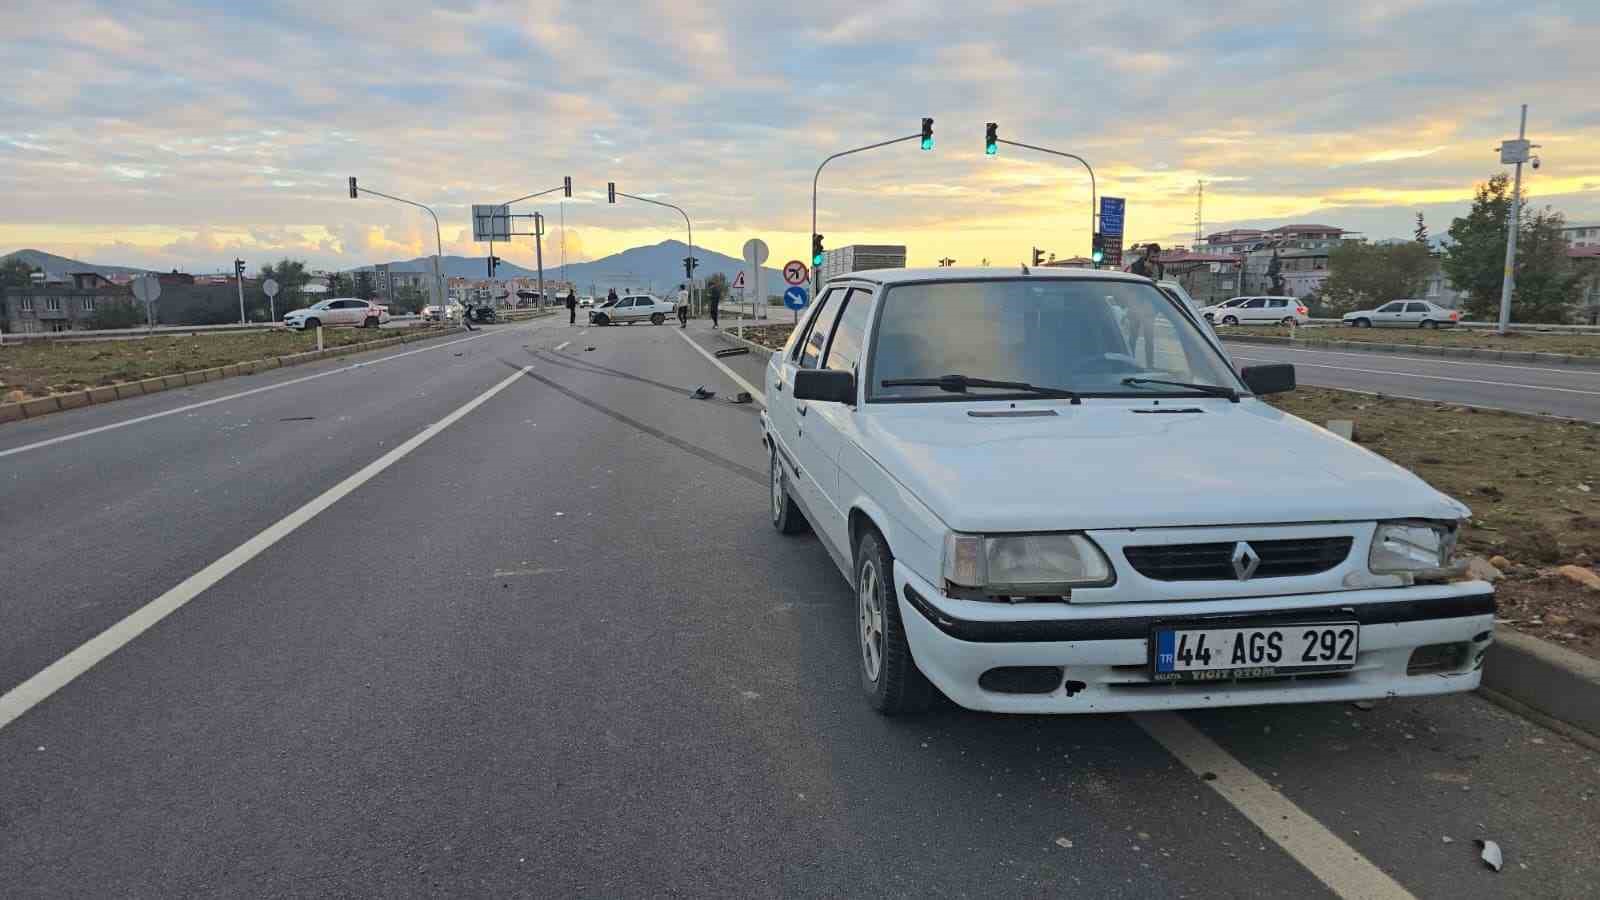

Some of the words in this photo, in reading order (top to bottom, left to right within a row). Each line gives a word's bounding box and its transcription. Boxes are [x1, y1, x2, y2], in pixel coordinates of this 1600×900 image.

[1160, 654, 1173, 664] TR
[1176, 633, 1212, 667] 44
[1231, 631, 1284, 665] AGS
[1301, 628, 1355, 663] 292
